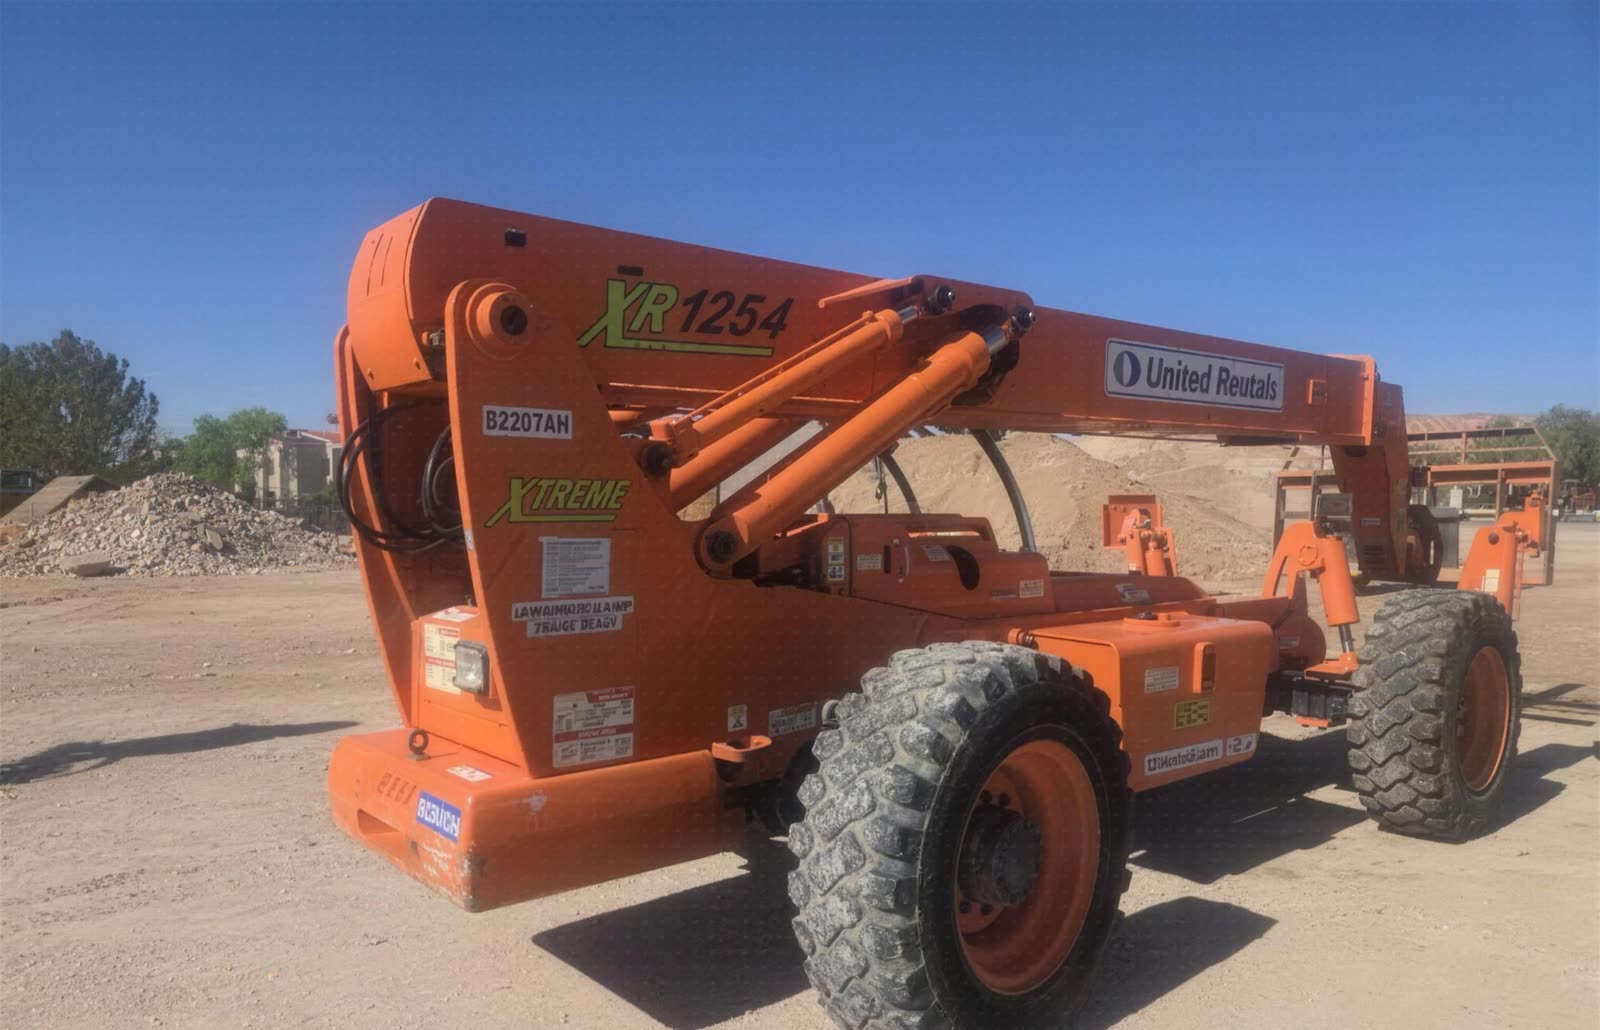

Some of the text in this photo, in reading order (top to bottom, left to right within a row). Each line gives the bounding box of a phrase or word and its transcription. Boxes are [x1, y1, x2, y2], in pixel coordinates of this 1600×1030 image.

[576, 279, 795, 348] XR 1254
[1146, 356, 1213, 394] United
[486, 410, 569, 434] B2207AH
[484, 477, 633, 528] XTREME
